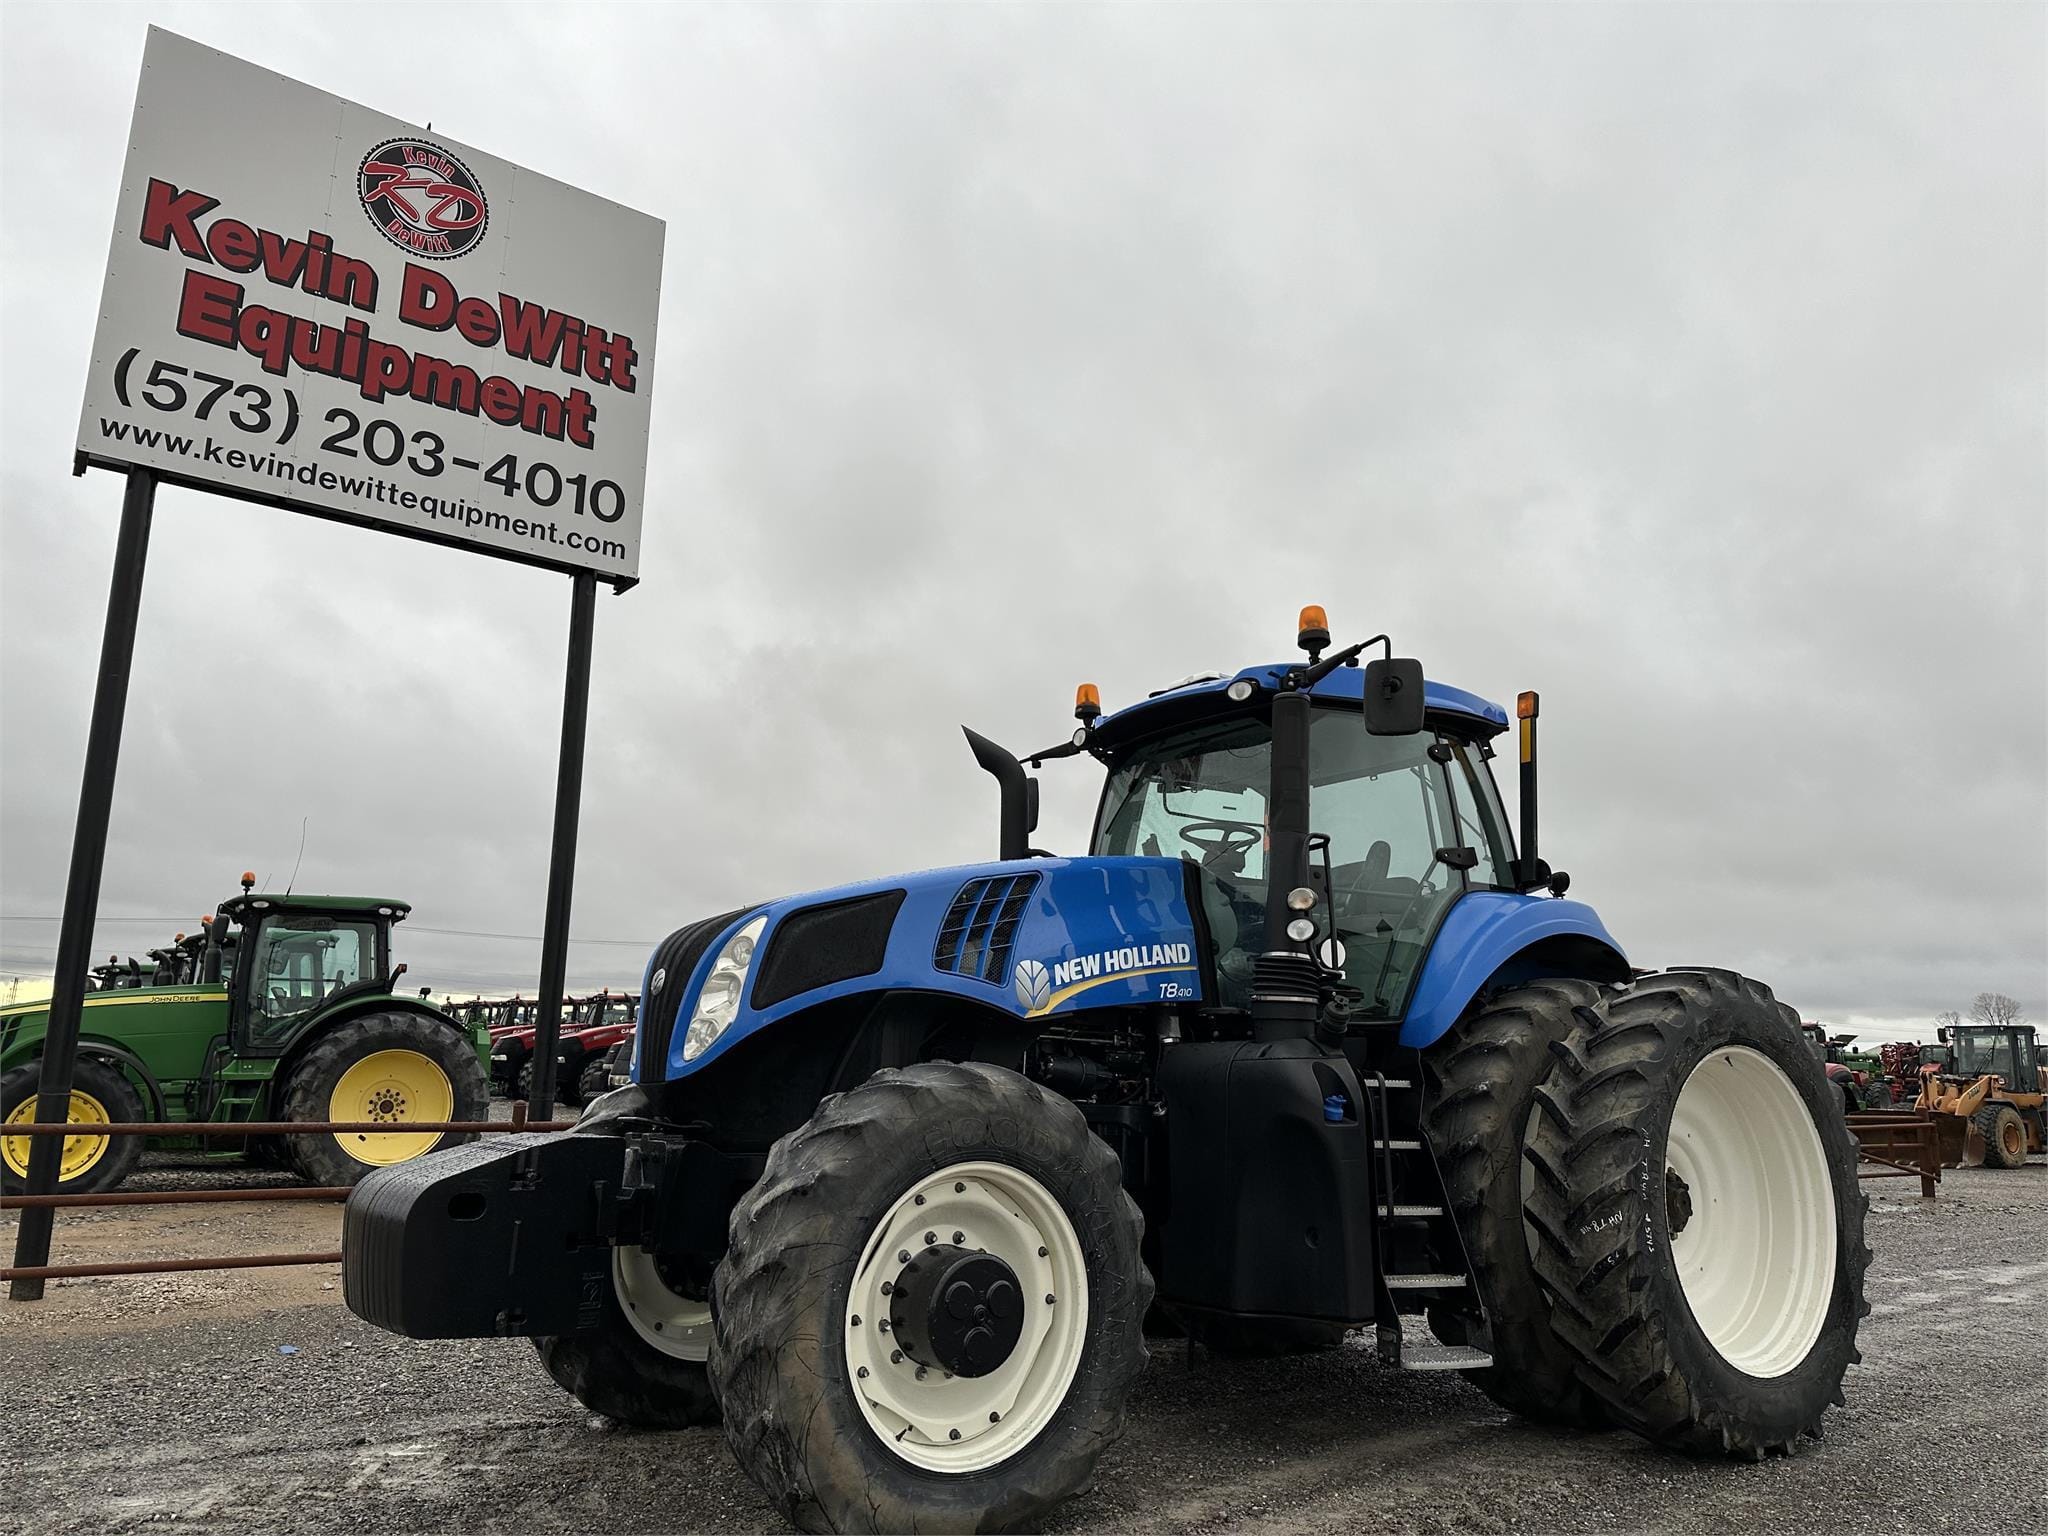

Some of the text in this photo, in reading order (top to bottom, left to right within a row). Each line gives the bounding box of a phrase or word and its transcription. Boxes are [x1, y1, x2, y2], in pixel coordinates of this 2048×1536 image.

[362, 160, 486, 230] KD
[402, 146, 456, 179] Kevin
[386, 218, 453, 253] DeWitt
[140, 177, 638, 393] Kevin DeWitt
[176, 268, 596, 450] Equipment
[113, 347, 626, 524] (573) 203-4010
[100, 417, 626, 560] www.kevindewittequipment.com
[1054, 943, 1191, 986] NEW HOLLAND
[1159, 982, 1193, 999] T8.410
